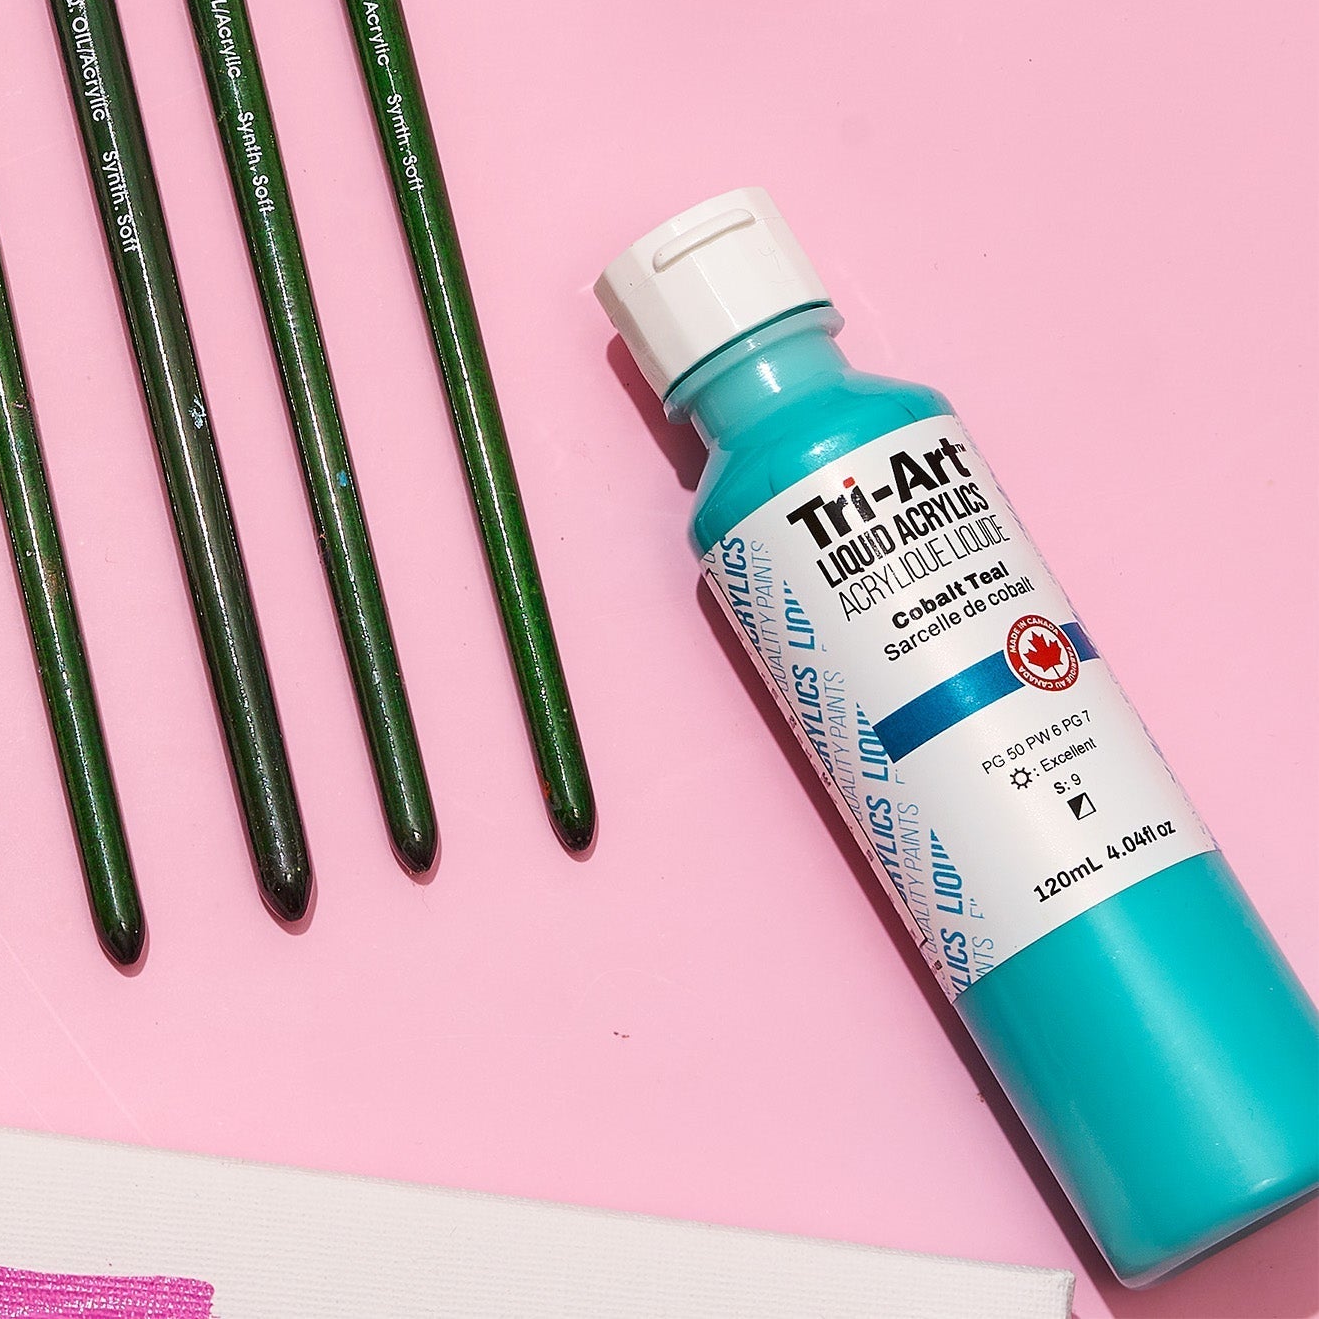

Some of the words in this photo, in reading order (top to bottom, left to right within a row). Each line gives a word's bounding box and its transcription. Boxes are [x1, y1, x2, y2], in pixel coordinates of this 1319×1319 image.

[71, 17, 106, 123] OIL/Acrylic
[237, 111, 261, 171] Synth.
[252, 174, 276, 213] Soft
[387, 94, 411, 152] Synth.
[402, 155, 425, 192] Soft
[102, 150, 125, 211] Synth.
[116, 214, 140, 253] Soft
[816, 524, 897, 589] LIQUID
[892, 482, 990, 545] ACRYLICS
[839, 537, 953, 621] ACRYLIQUE
[944, 514, 1011, 560] LIQUIDE
[884, 602, 962, 661] Sarcelle
[963, 596, 987, 619] de
[988, 575, 1036, 606] cobalt
[891, 578, 968, 629] Cobalt
[963, 561, 1010, 590] Teal
[981, 754, 1005, 775] PG
[1006, 743, 1027, 761] 50
[1026, 730, 1051, 750] PW
[1040, 737, 1097, 774] Excellent
[1033, 856, 1103, 903] 120mL
